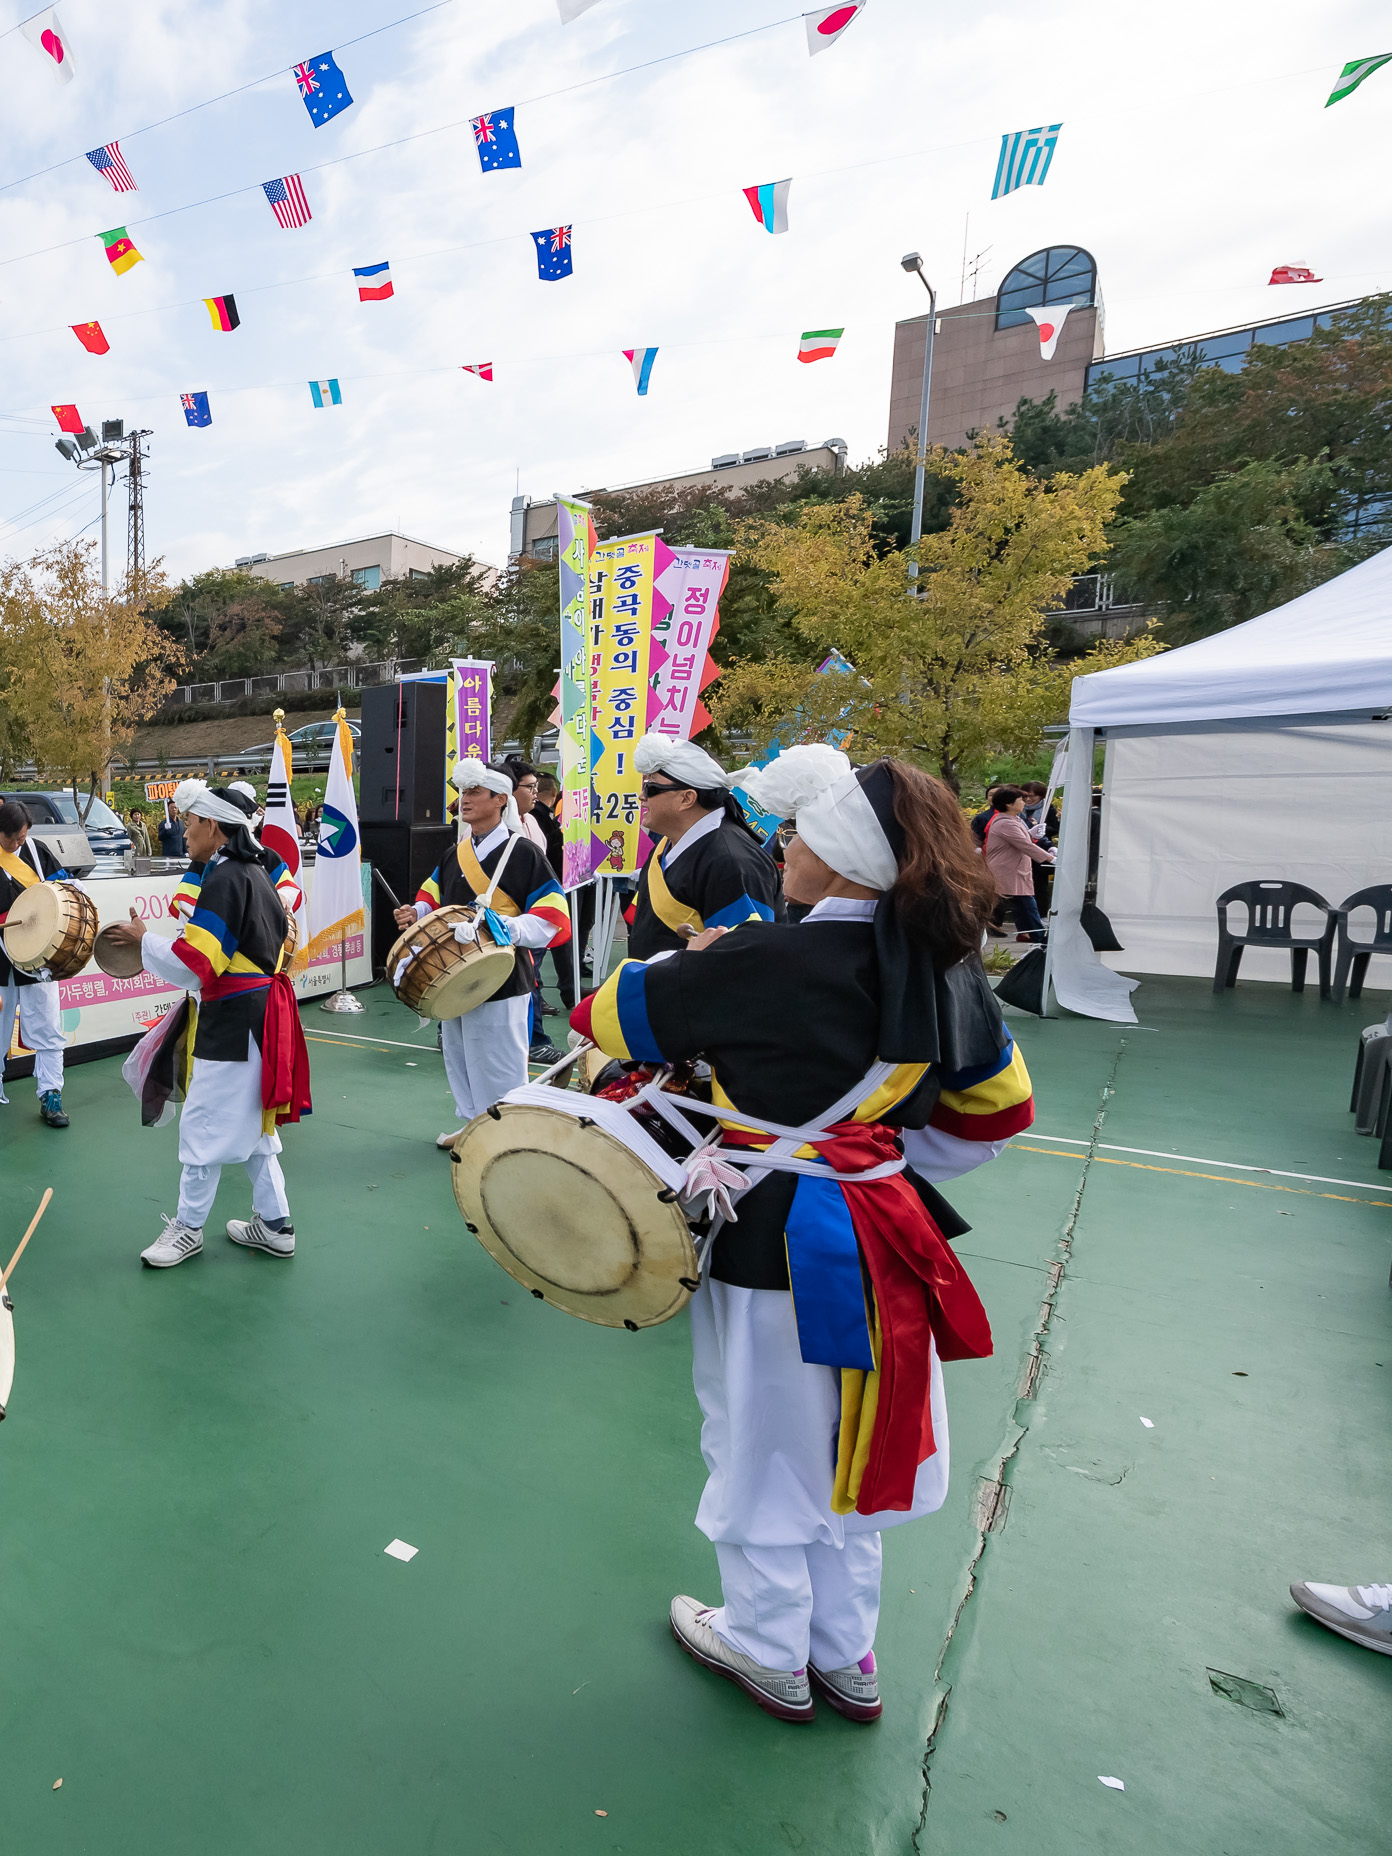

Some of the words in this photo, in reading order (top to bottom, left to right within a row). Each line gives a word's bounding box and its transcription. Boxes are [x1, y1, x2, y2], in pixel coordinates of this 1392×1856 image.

[609, 564, 643, 674] 중곡동의
[607, 687, 639, 740] 중심
[135, 893, 175, 921] 201
